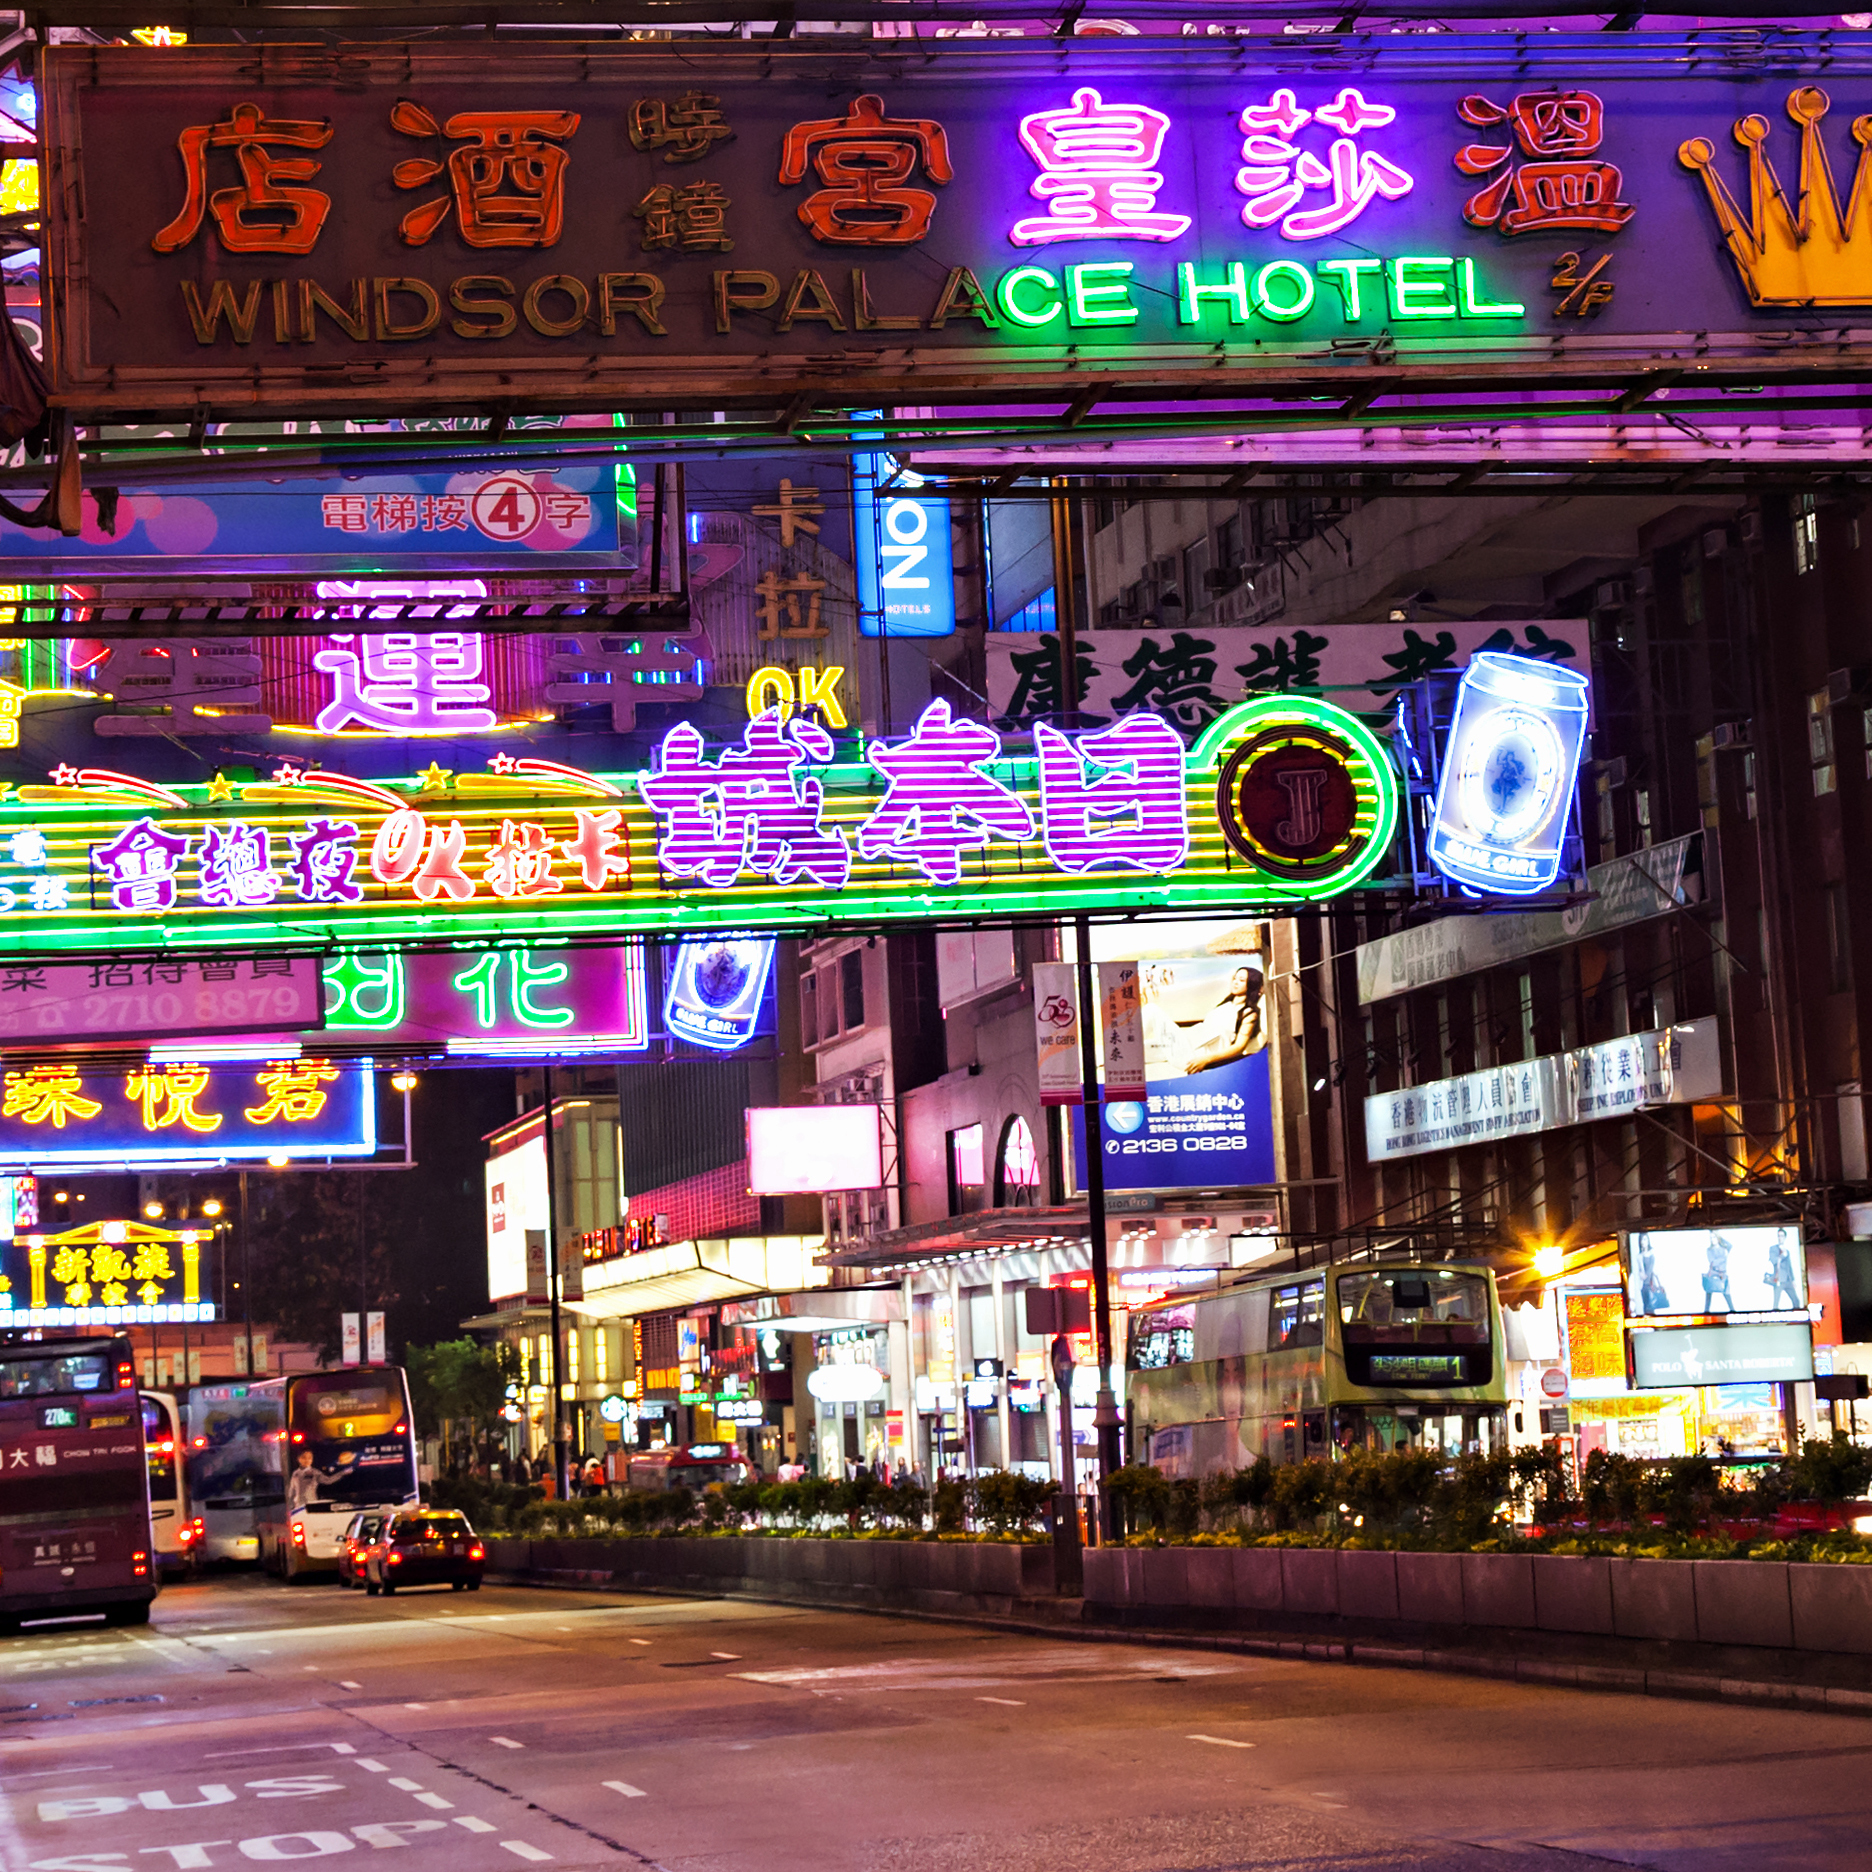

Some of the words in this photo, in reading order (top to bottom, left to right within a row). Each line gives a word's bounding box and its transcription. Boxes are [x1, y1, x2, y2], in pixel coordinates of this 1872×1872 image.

[180, 272, 668, 346] WINDSOR
[713, 257, 1139, 334] PALACE
[1178, 255, 1528, 326] HOTEL
[83, 993, 183, 1027] 2710
[194, 986, 300, 1023] 8879
[1040, 1034, 1054, 1045] we
[1056, 1034, 1076, 1045] care
[1147, 1093, 1245, 1113] 香港展銷中心
[1122, 1138, 1178, 1154] 2136
[1183, 1136, 1247, 1151] 0828
[1451, 1356, 1464, 1380] 1
[1652, 1361, 1682, 1373] POLO
[1705, 1358, 1742, 1371] SANTA
[1743, 1356, 1795, 1369] ROBERTA
[38, 1774, 346, 1822] BUS
